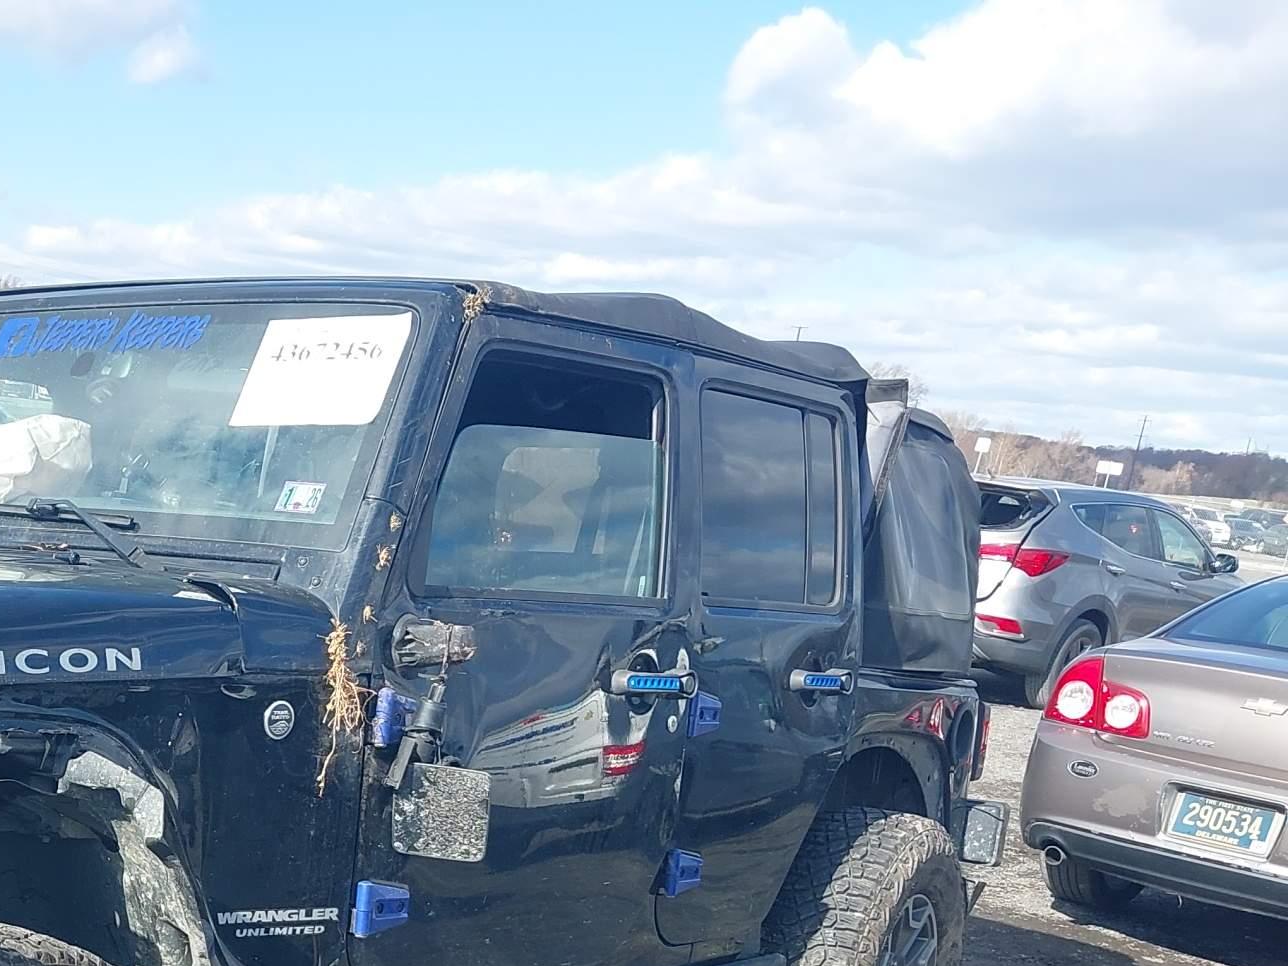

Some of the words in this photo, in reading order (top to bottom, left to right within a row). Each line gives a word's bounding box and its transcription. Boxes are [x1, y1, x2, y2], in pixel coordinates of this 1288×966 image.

[1182, 802, 1264, 841] 290534
[217, 907, 339, 925] WRANGLER
[235, 925, 326, 938] UNLIMITED
